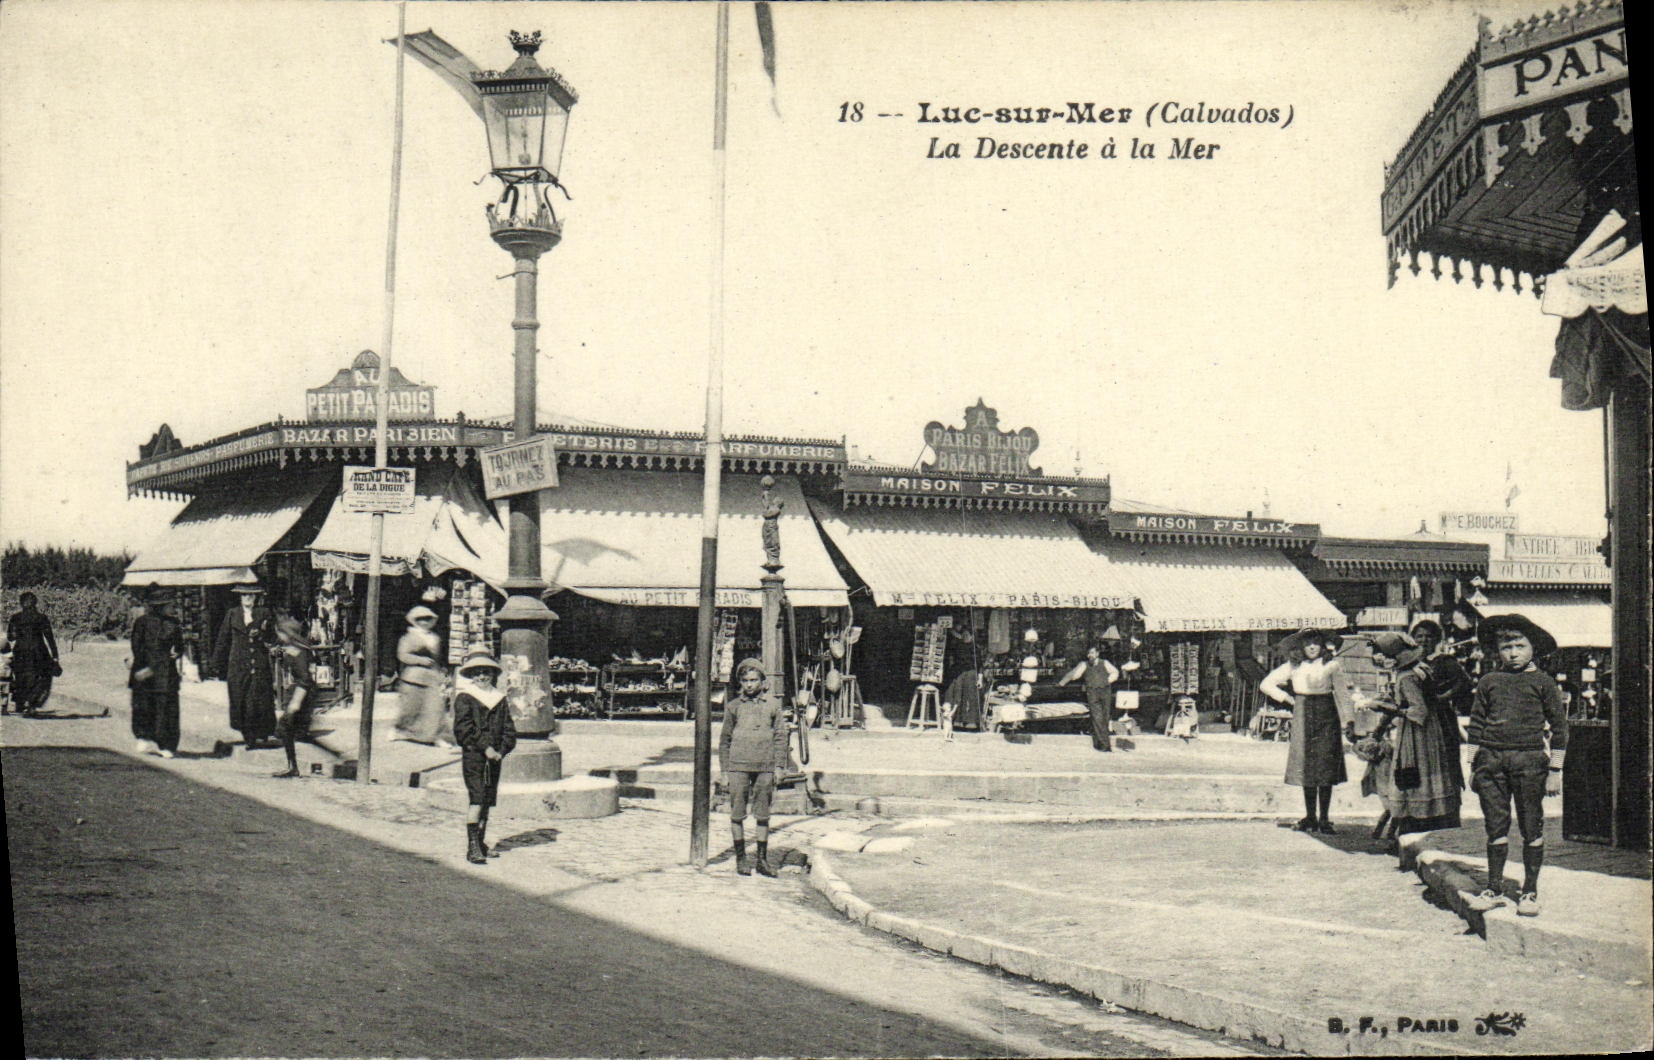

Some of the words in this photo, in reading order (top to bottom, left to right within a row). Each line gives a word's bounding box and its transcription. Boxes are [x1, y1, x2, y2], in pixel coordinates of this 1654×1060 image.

[307, 392, 349, 416] PETIT
[352, 389, 430, 415] PAADIS
[283, 428, 349, 443] BAZAR
[503, 432, 637, 450] PETERIE
[932, 428, 982, 449] PARIS
[988, 431, 1032, 451] BIJOU
[940, 451, 987, 475] BAZAR
[353, 483, 364, 492] DE
[366, 483, 377, 492] LA
[380, 483, 405, 492] DIGUE
[495, 474, 511, 490] AU
[516, 469, 545, 486] PAS
[881, 477, 961, 492] MAISON
[981, 482, 1078, 497] FELIX
[1136, 516, 1197, 530] MAISON
[1213, 519, 1294, 534] FELIX
[1467, 513, 1516, 530] BOUCHEZ
[645, 592, 687, 605] PETIT
[924, 592, 979, 605] FELIX
[1183, 619, 1226, 631] FELIX
